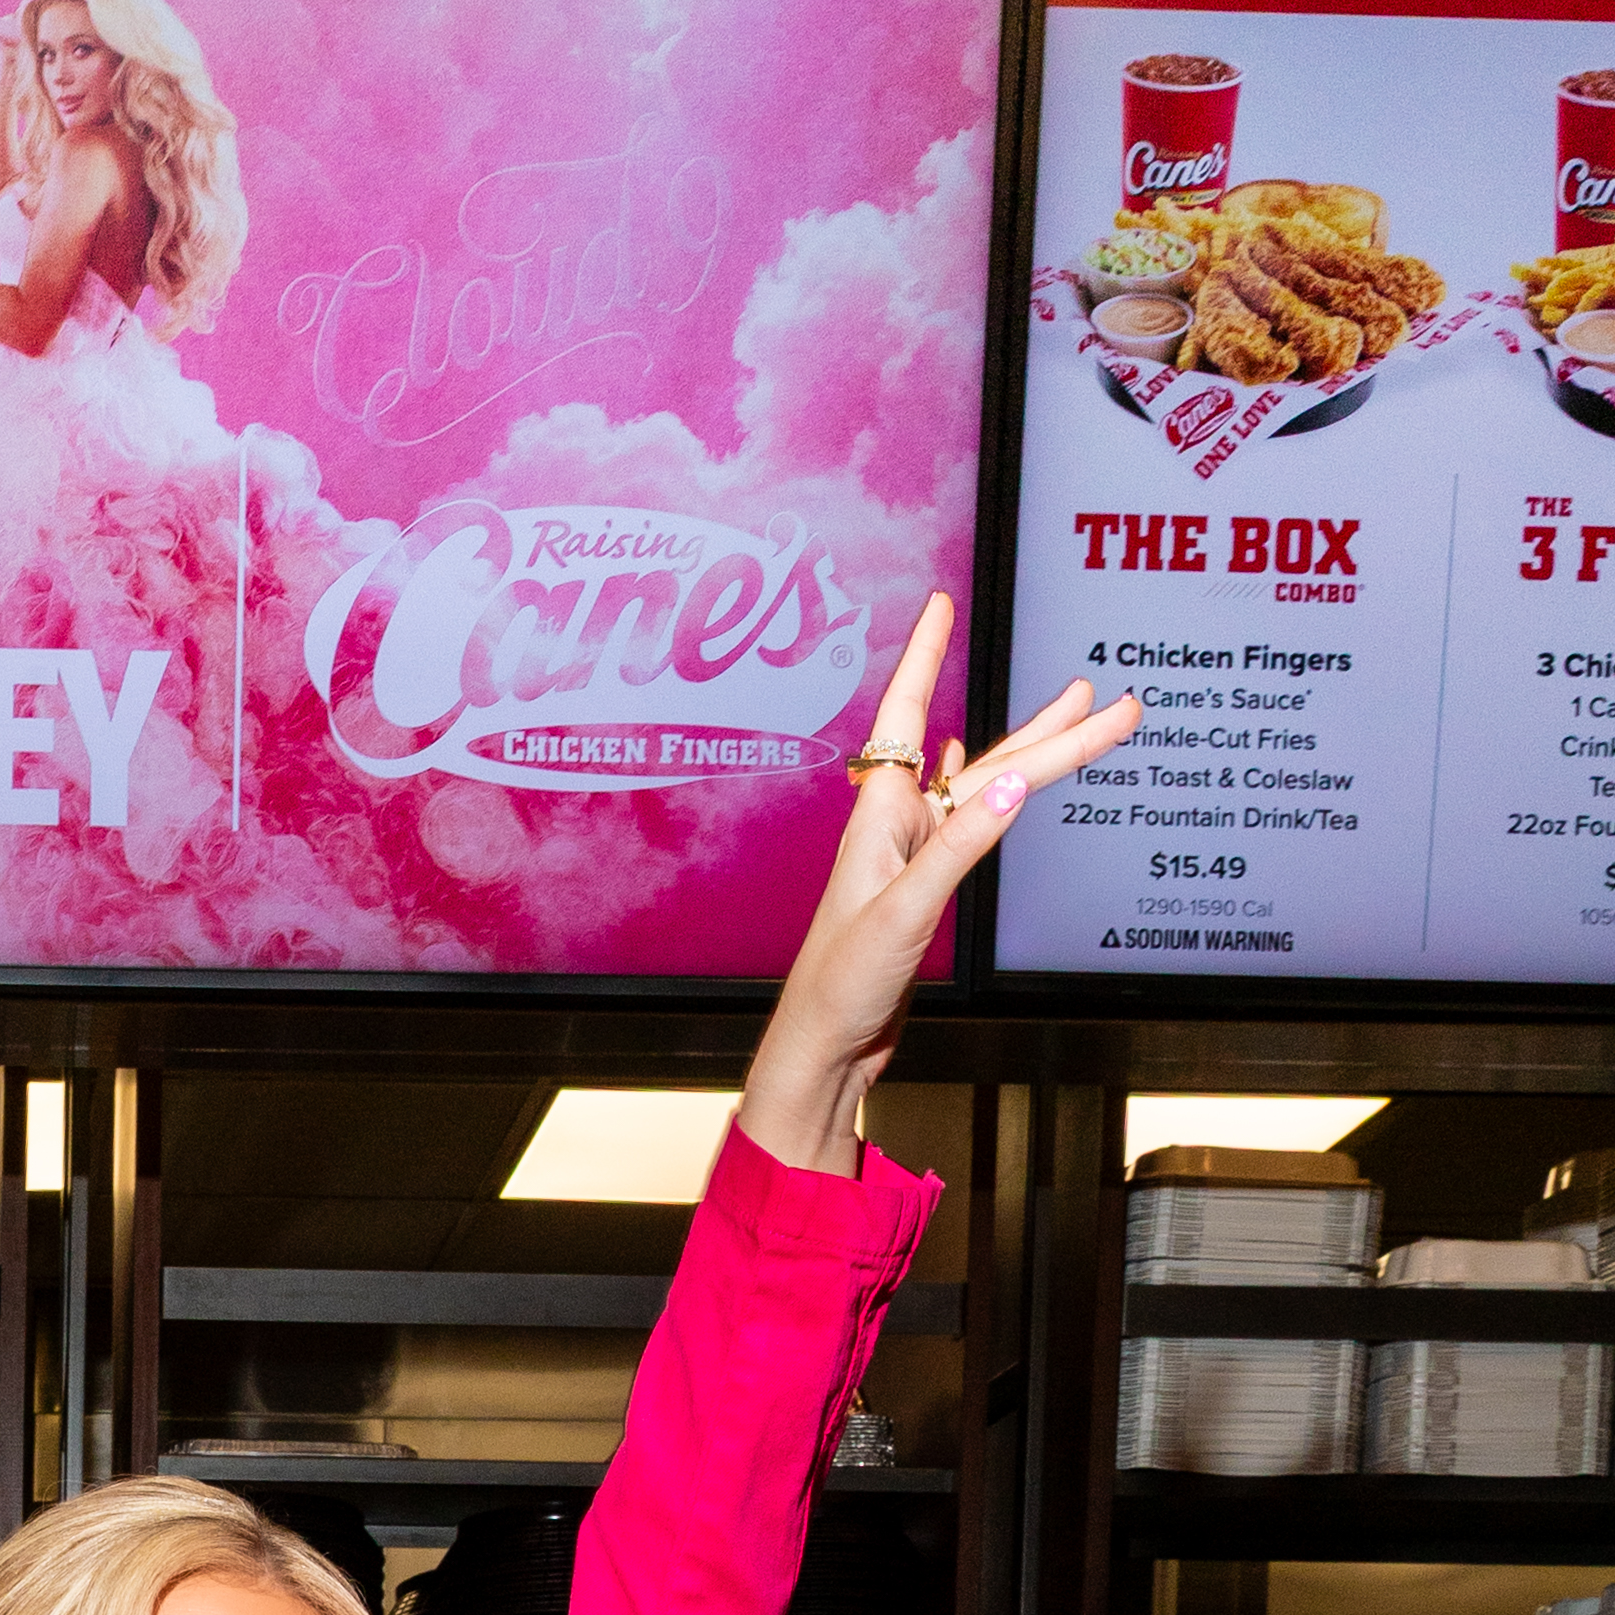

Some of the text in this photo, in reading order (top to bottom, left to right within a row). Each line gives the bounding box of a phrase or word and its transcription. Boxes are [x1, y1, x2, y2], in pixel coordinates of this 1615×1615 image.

[1125, 139, 1228, 196] Cane's
[1193, 389, 1286, 481] ONE LOVE
[1525, 496, 1574, 517] THE
[525, 518, 706, 575] Raising
[1074, 513, 1361, 576] THE BOX
[1519, 525, 1558, 581] 3
[328, 498, 866, 765] Cane's
[1088, 641, 1353, 677] 4 Chicken Fingers
[1536, 652, 1615, 678] 3 Chi
[1142, 686, 1224, 709] Cane's
[1571, 695, 1582, 718] 1
[502, 730, 802, 768] CHICKEN FINGERS
[1257, 728, 1317, 751] Fries
[1076, 765, 1355, 791] Texas Toast & Coleslaw
[1062, 803, 1359, 831] 22oz Fountain Drink/Tea
[1507, 813, 1567, 835] 22oz
[1148, 851, 1247, 881] $15.49
[1136, 898, 1274, 917] 1290-1590 Cal
[1124, 928, 1295, 953] SODIUM WARNING
